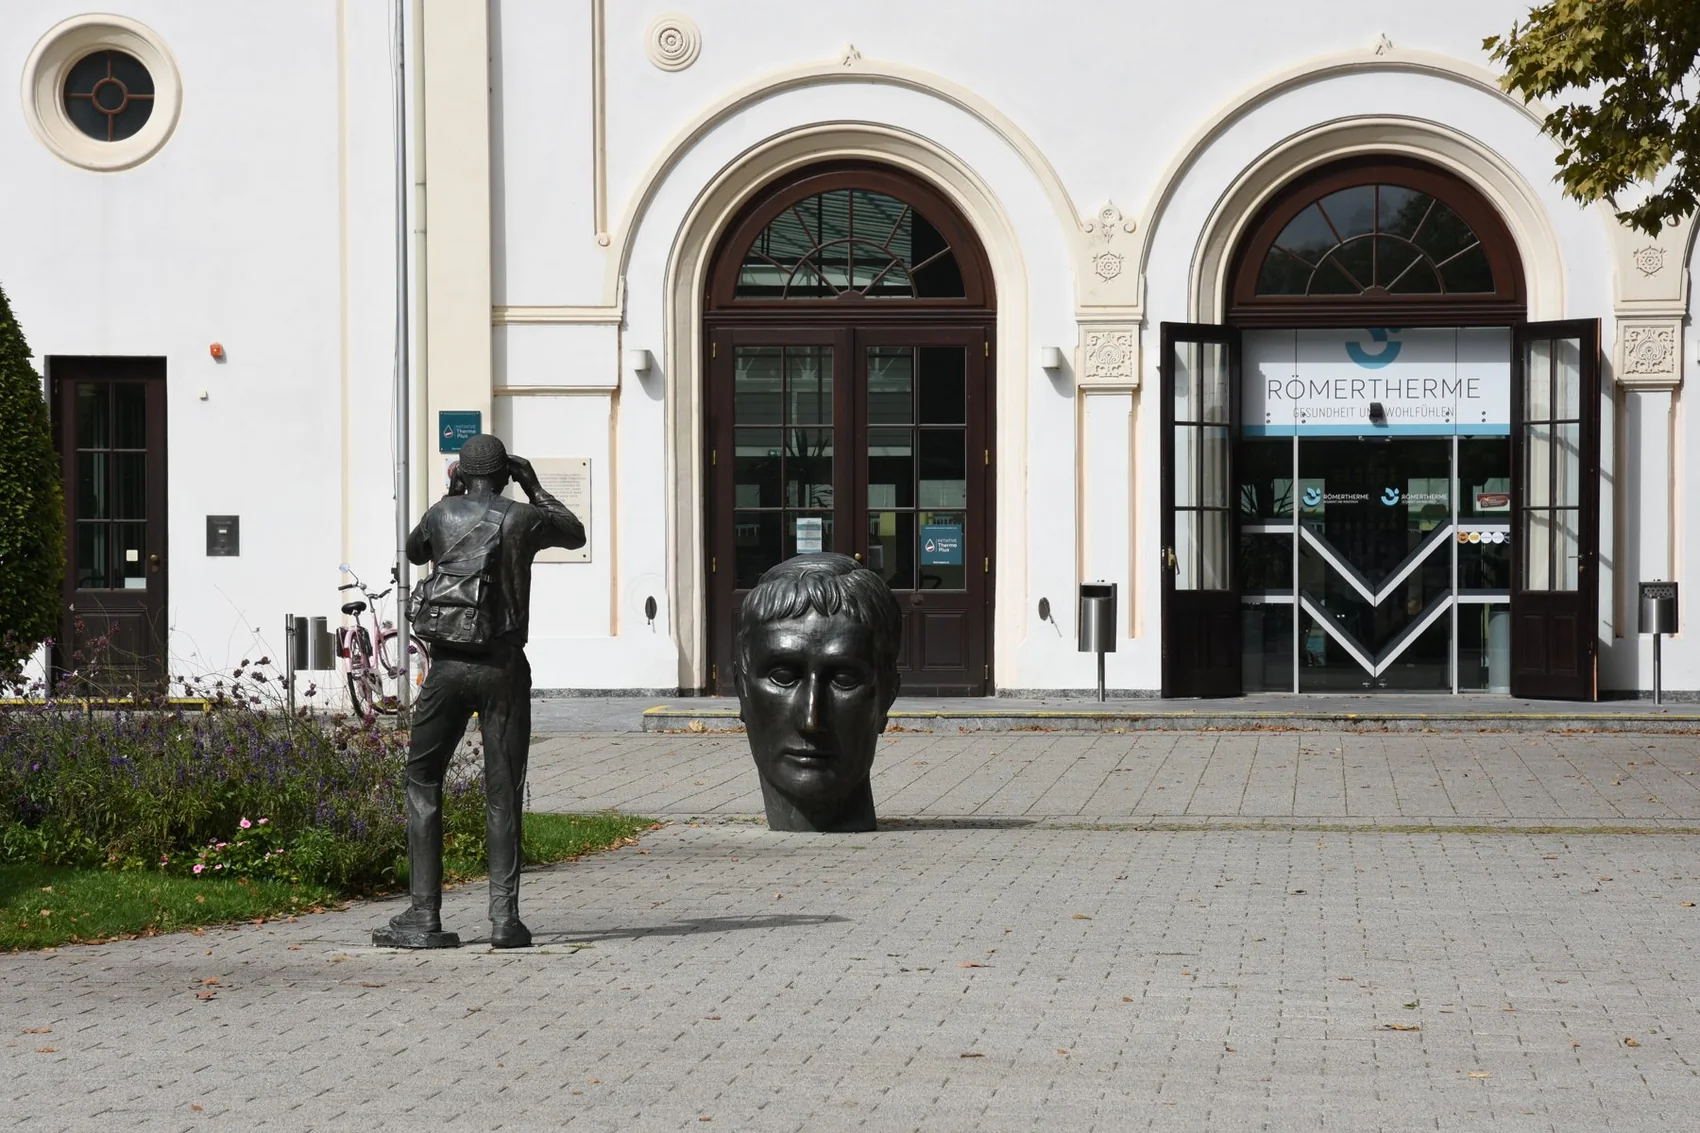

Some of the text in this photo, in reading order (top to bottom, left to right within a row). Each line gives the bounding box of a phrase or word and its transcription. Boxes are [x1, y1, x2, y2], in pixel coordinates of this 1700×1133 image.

[1268, 374, 1480, 400] RÖMERTHERME
[1293, 407, 1356, 418] GESUNDHEIT
[1385, 404, 1454, 418] WOHLFÜHLEN
